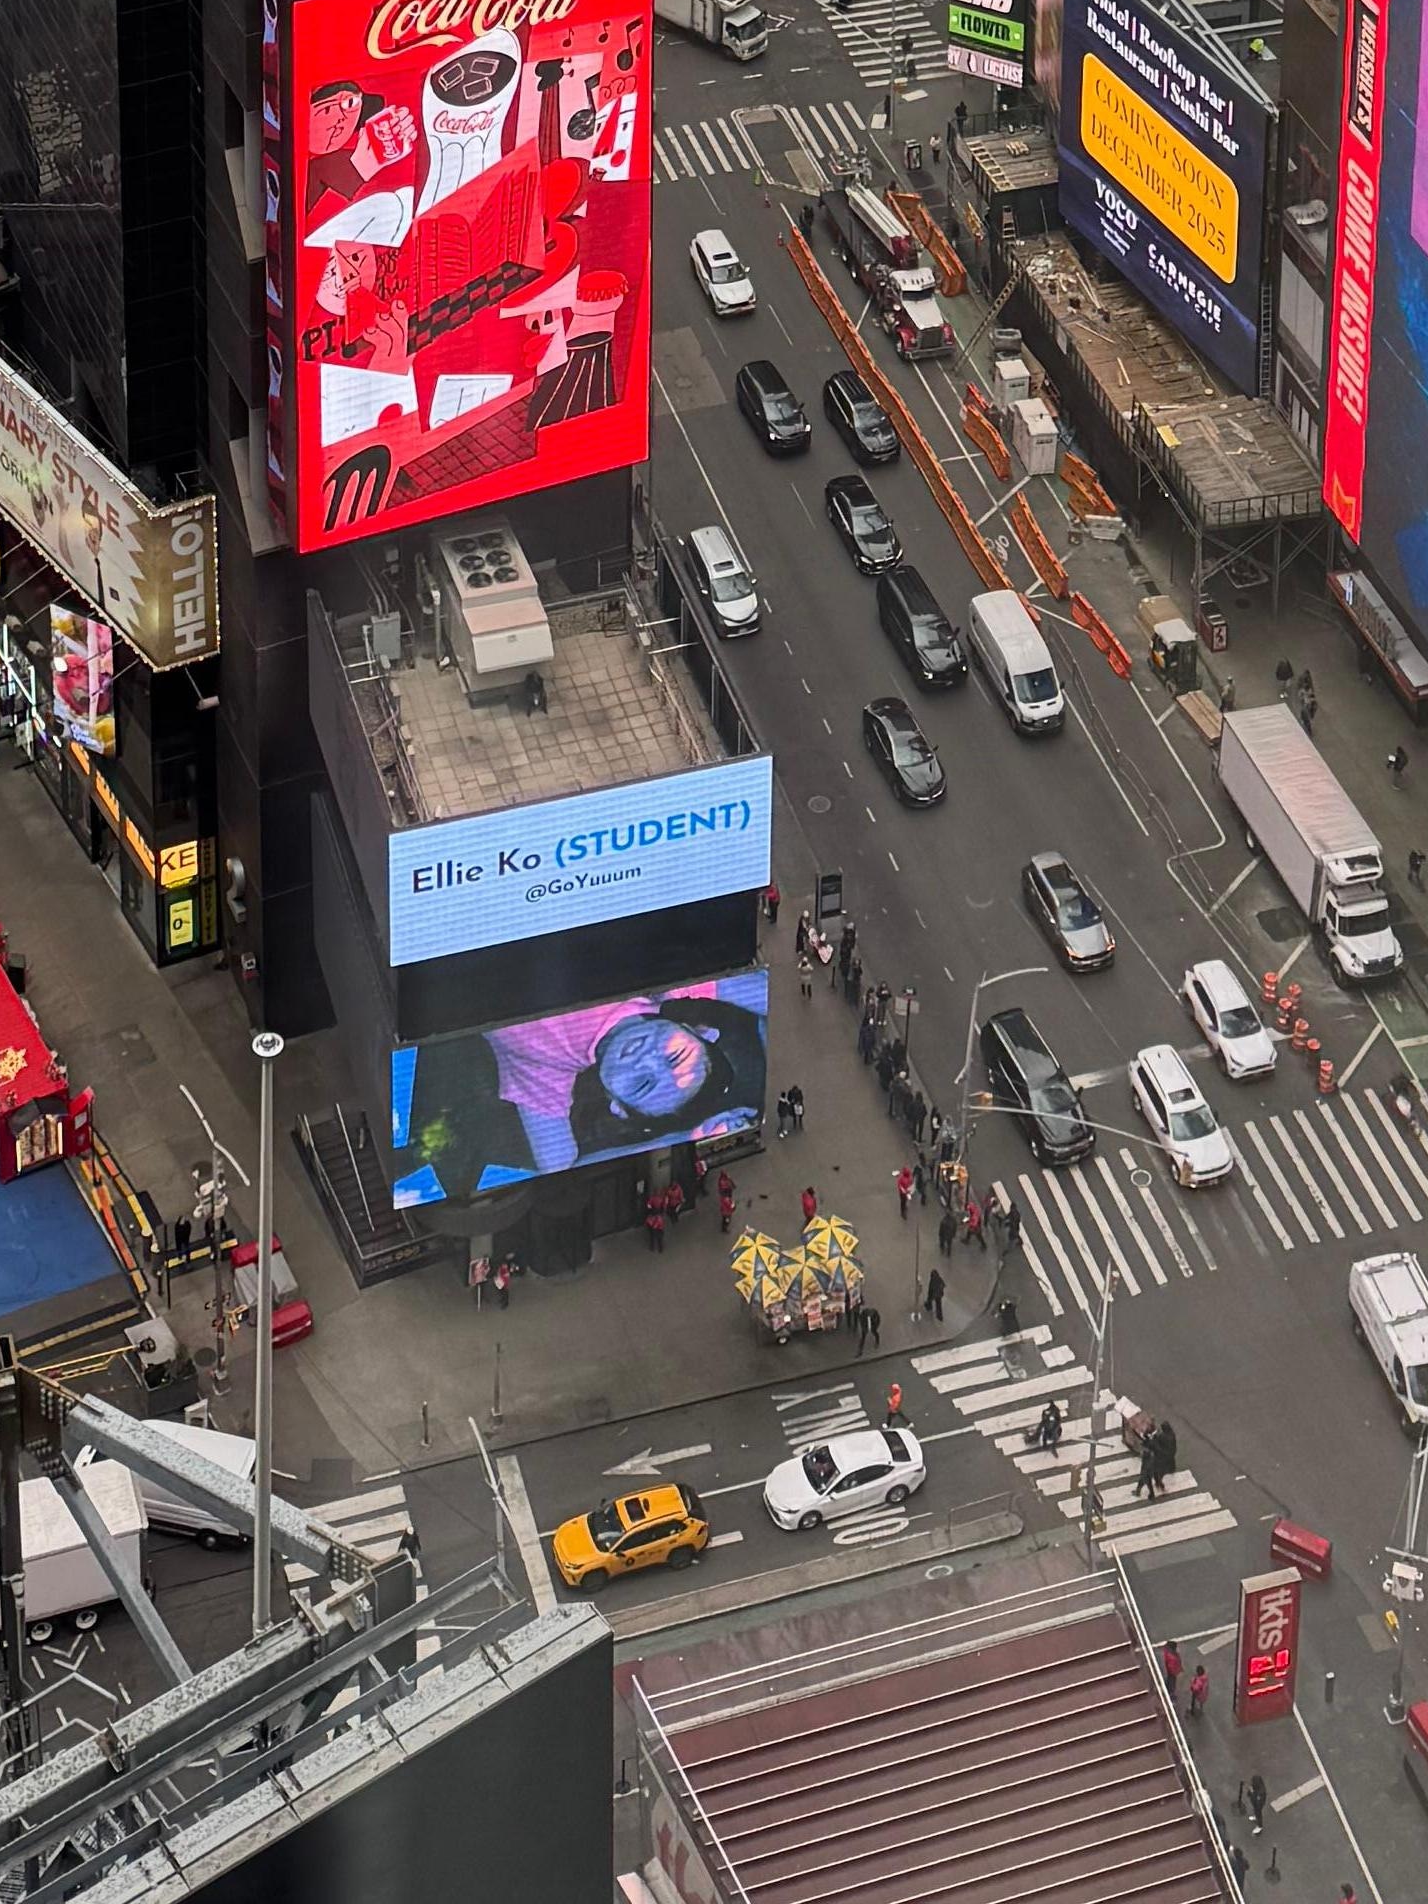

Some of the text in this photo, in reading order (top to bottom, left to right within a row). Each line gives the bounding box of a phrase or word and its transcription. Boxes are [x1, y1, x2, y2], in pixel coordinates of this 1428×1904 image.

[960, 12, 1010, 42] FLOWER
[1138, 21, 1195, 92] Rooftop
[1199, 74, 1227, 114] Bar
[1087, 7, 1239, 157] Restaurant Sushi Bar
[1091, 113, 1184, 219] DECEMBER
[1187, 203, 1227, 256] 2025
[1095, 78, 1225, 210] COMING SOON
[1148, 243, 1222, 322] CARNEGIE
[1335, 158, 1374, 427] COME INSIDE!
[52, 451, 122, 540] STYLE
[171, 508, 207, 655] HELLO!
[411, 800, 752, 894] Ellie Ko (STUDENT)
[524, 862, 643, 903] @GoYuuum
[1258, 1587, 1293, 1650] tkts
